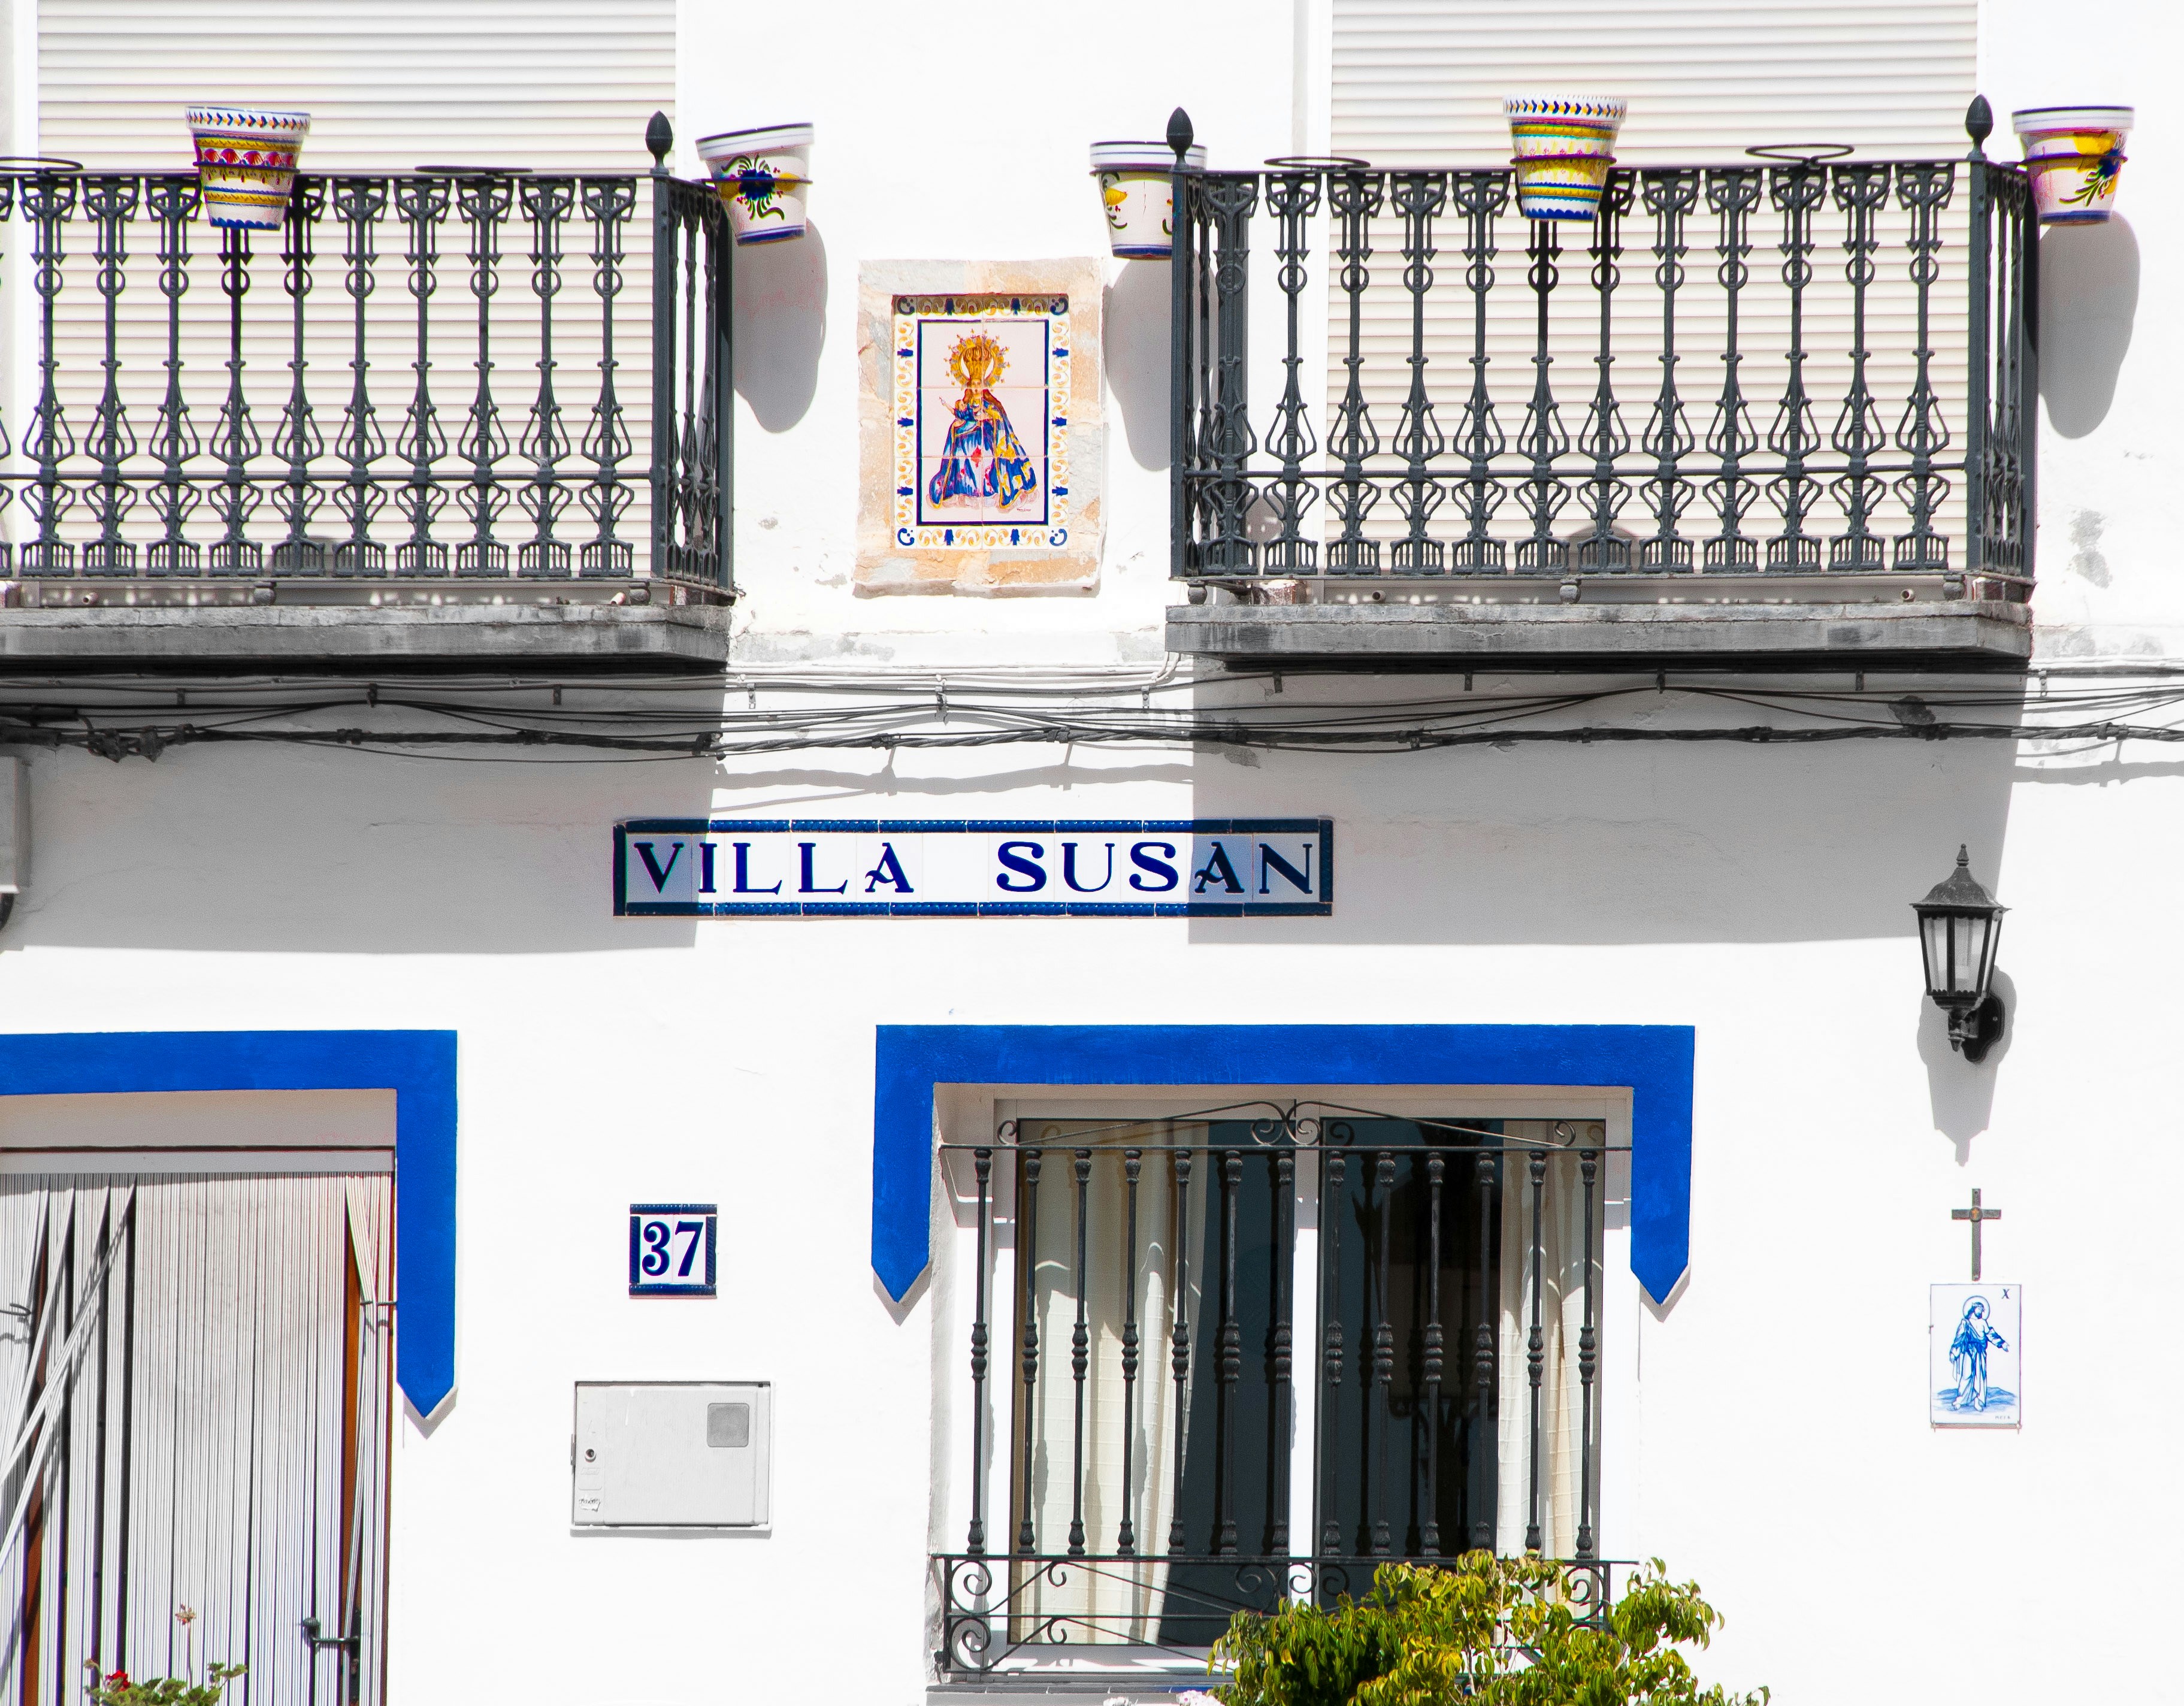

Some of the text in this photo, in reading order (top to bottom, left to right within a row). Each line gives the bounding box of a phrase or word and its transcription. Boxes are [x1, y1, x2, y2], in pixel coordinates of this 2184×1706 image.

[633, 840, 1314, 897] VILLA SUSAN
[642, 1220, 704, 1277] 37
[2001, 1288, 2010, 1299] X
